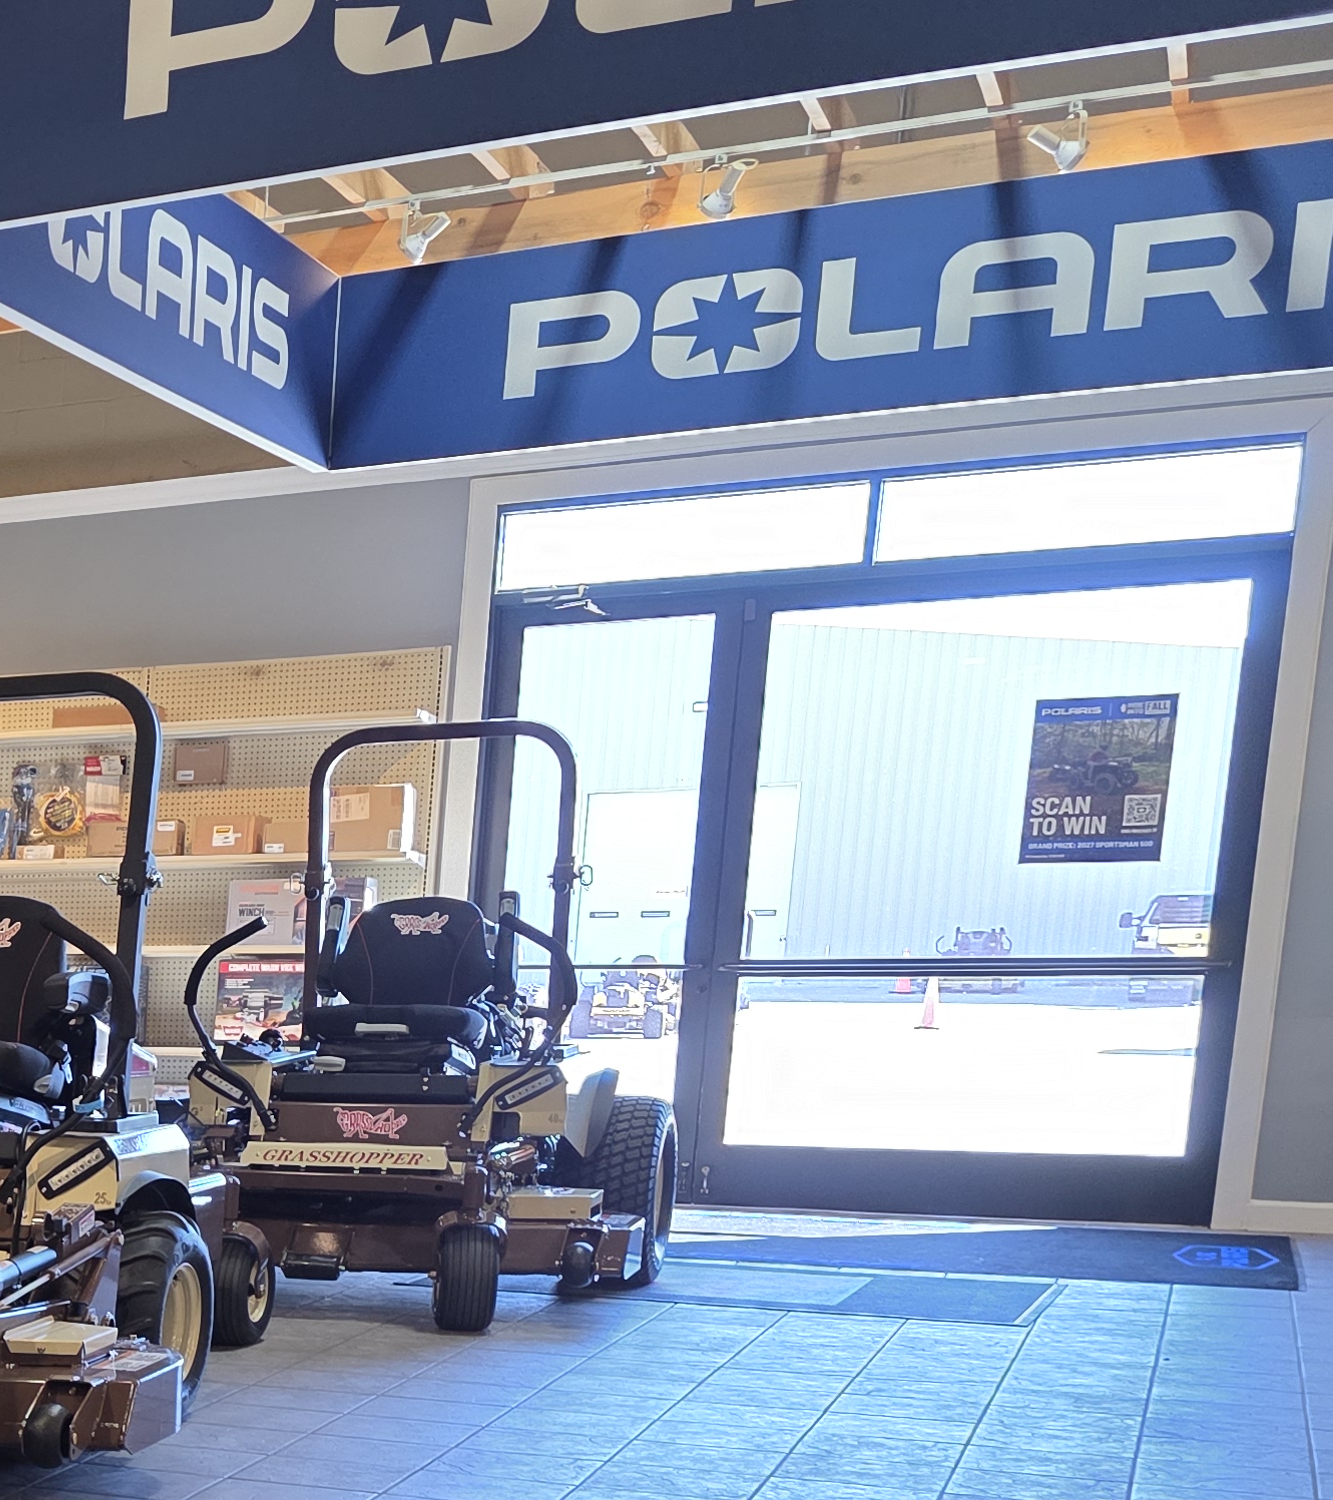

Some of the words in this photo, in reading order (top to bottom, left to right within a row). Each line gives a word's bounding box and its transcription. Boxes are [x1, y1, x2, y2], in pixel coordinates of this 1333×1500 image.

[1041, 706, 1103, 716] POLARIS
[1146, 701, 1169, 711] FALL
[1031, 796, 1091, 816] SCAN
[1030, 817, 1057, 836] TO
[1063, 816, 1107, 835] WIN
[262, 1148, 425, 1166] GRASSHOPPER
